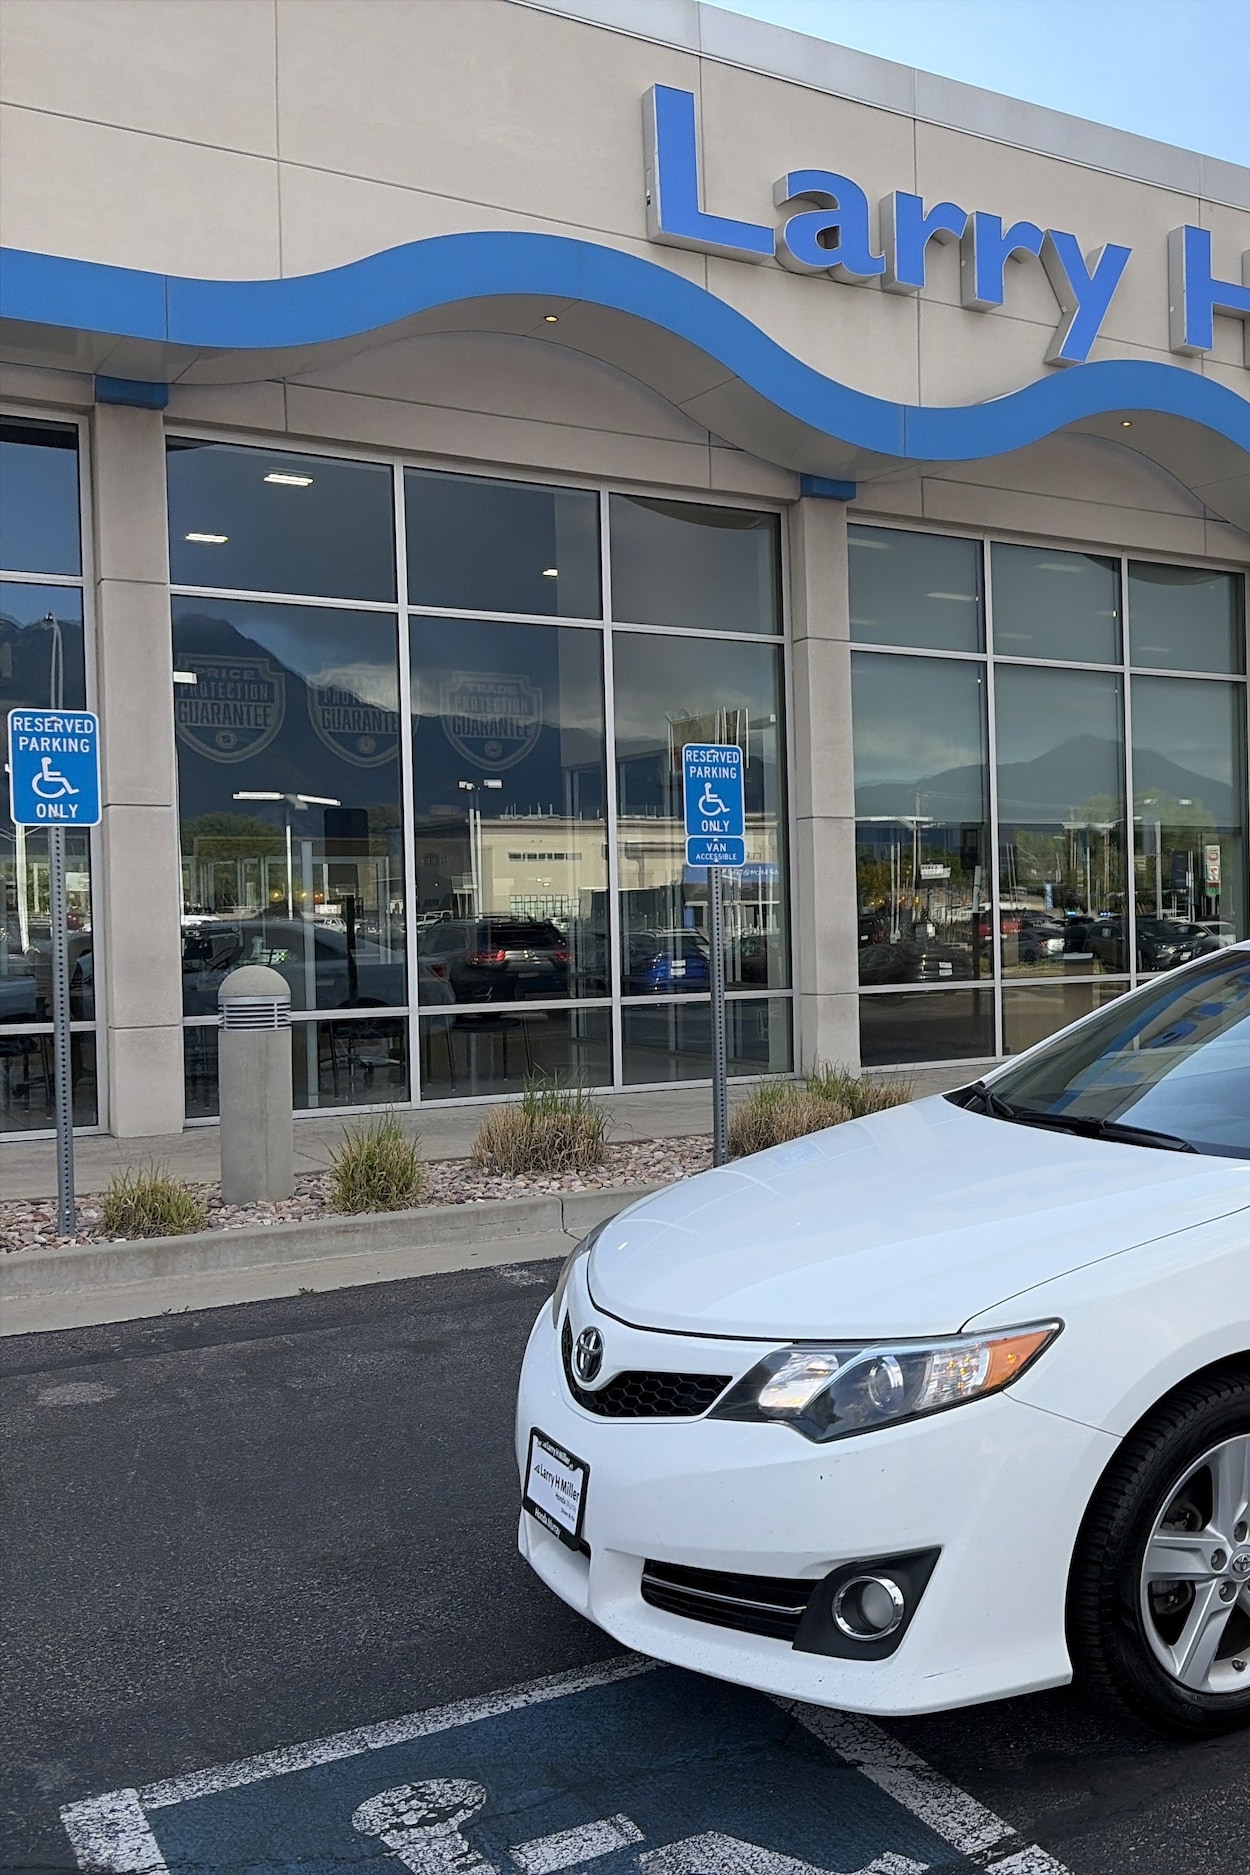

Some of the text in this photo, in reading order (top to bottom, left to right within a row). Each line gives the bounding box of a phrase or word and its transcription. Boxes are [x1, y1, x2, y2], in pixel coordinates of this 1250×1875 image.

[643, 84, 1132, 367] Larry
[193, 667, 255, 680] PRICE
[180, 682, 268, 700] PROTECTION
[465, 683, 518, 694] TRADE
[455, 696, 529, 713] PROTECTION
[178, 701, 273, 727] GUARANTEE
[322, 707, 398, 732] GUARANTE
[13, 717, 94, 734] RESERVED
[453, 716, 531, 738] GUARANTEE
[19, 737, 90, 753] PARKING
[685, 750, 740, 763] RESERVED
[689, 766, 737, 779] PARKING
[36, 803, 79, 818] ONLY
[701, 820, 730, 832] ONLY
[706, 843, 727, 852] VAN
[540, 1463, 555, 1488] Larry
[560, 1478, 580, 1503] Miller
[534, 1507, 548, 1525] Honda
